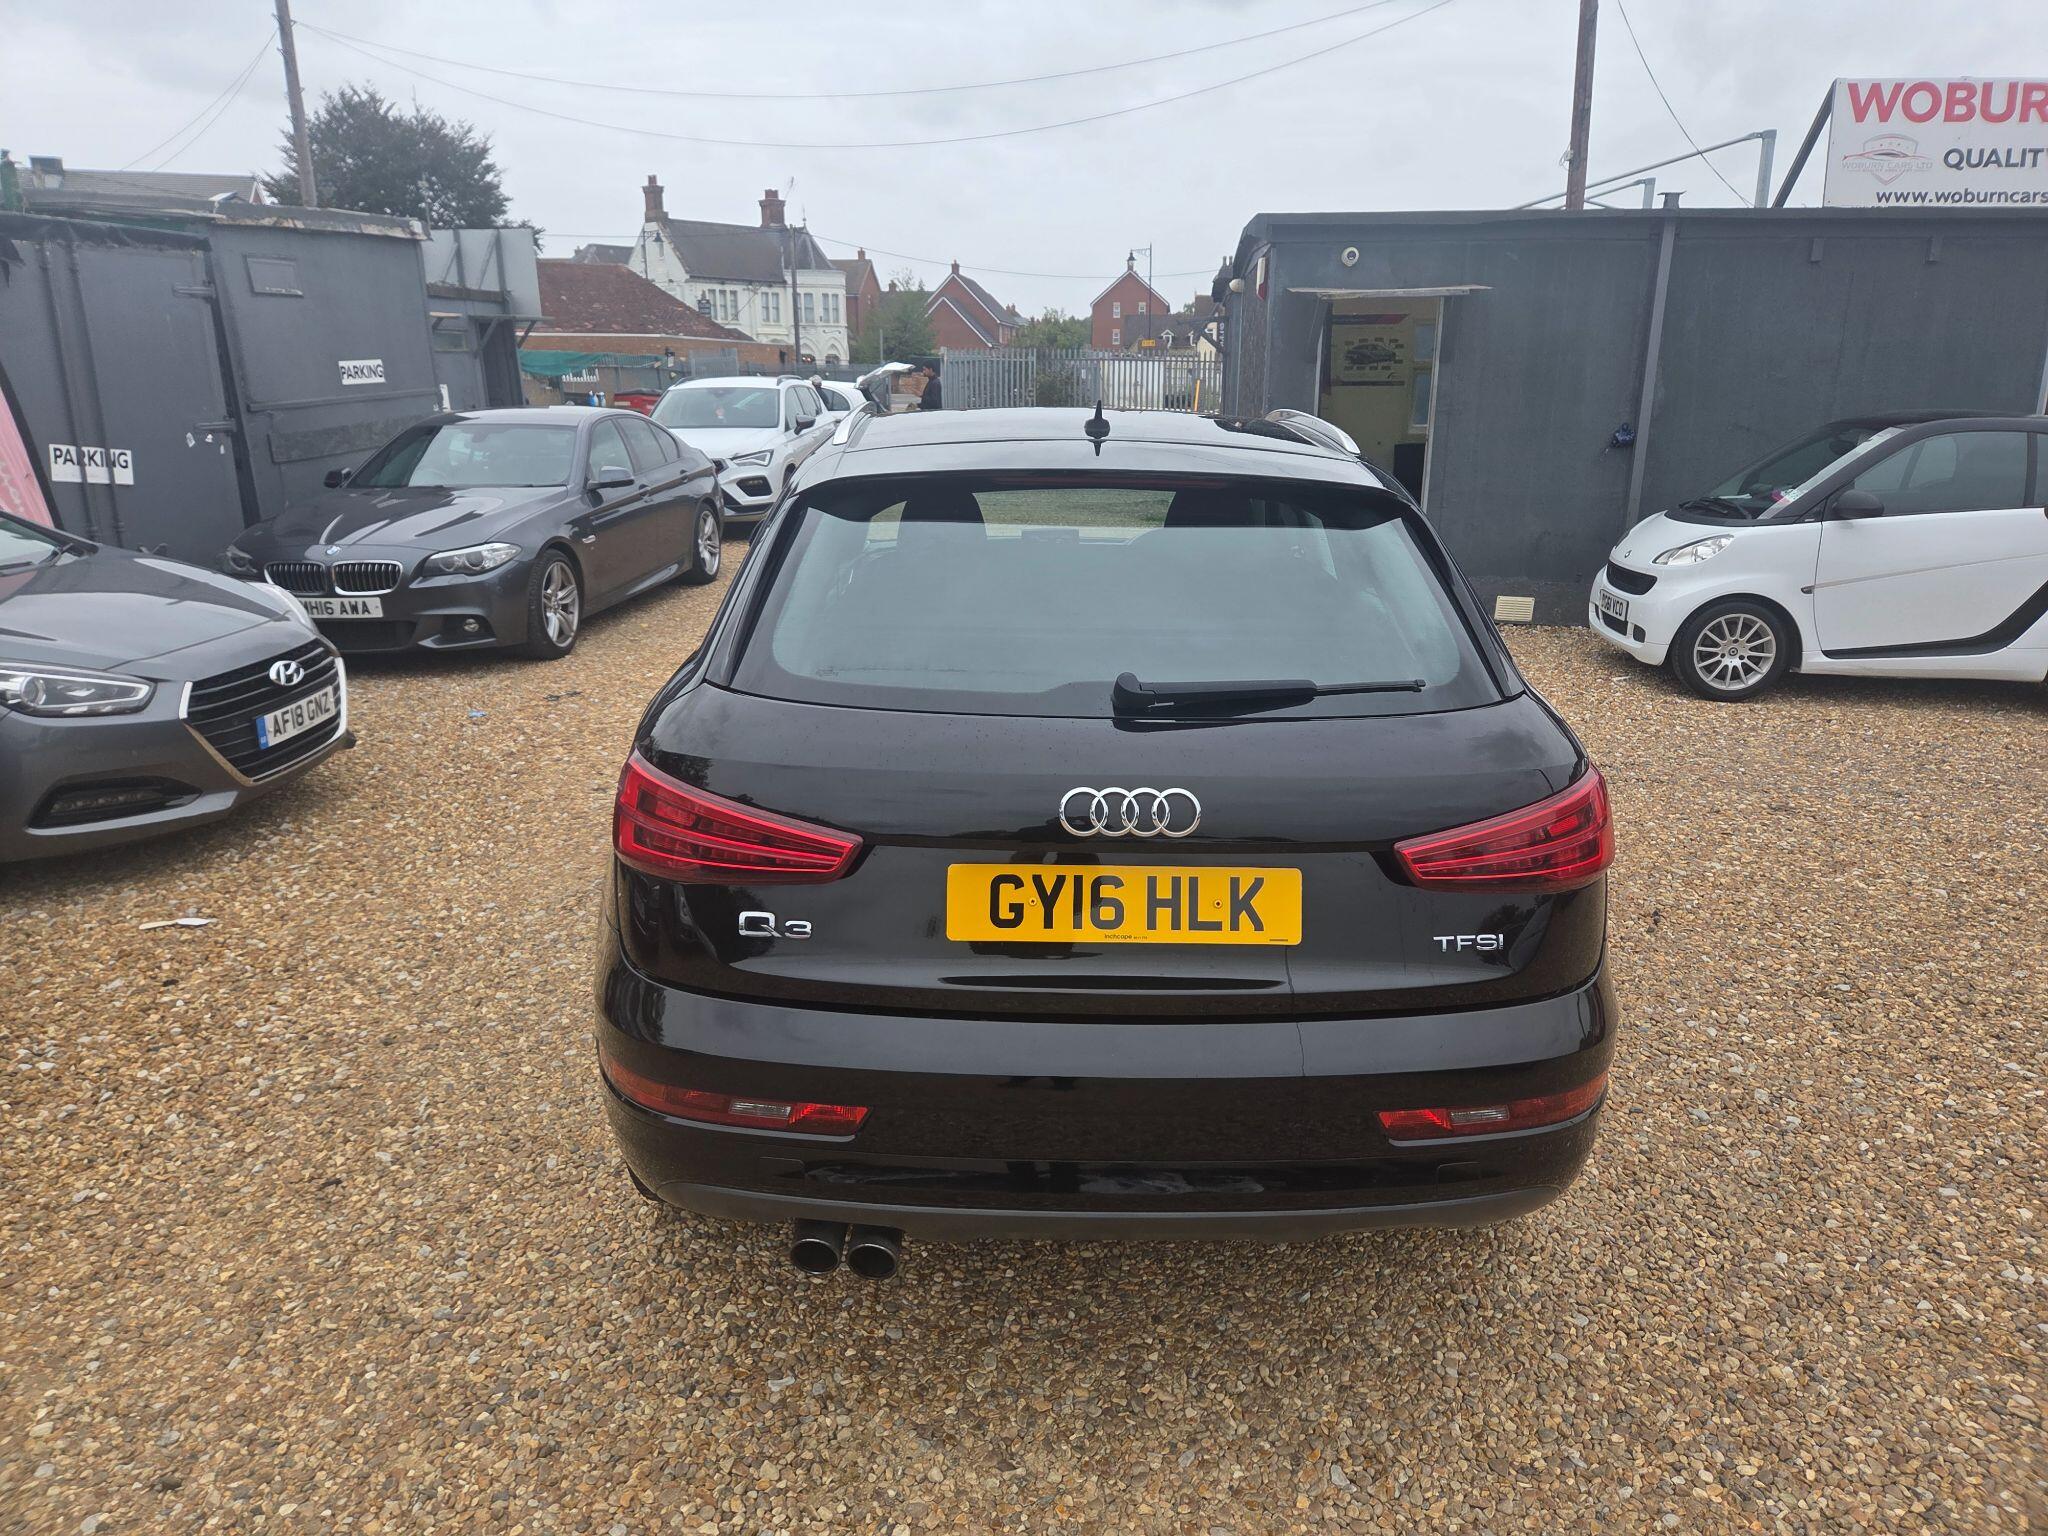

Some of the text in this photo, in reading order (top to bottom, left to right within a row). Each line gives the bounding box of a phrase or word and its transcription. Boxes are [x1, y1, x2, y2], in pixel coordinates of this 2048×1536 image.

[1944, 148, 2048, 170] QUALIT
[341, 363, 384, 380] PARKING
[53, 447, 129, 469] PARKING
[339, 600, 371, 615] AWA
[273, 691, 331, 738] AF18 GNZ
[989, 873, 1265, 931] GY16 HLK
[1433, 934, 1504, 952] TFSI
